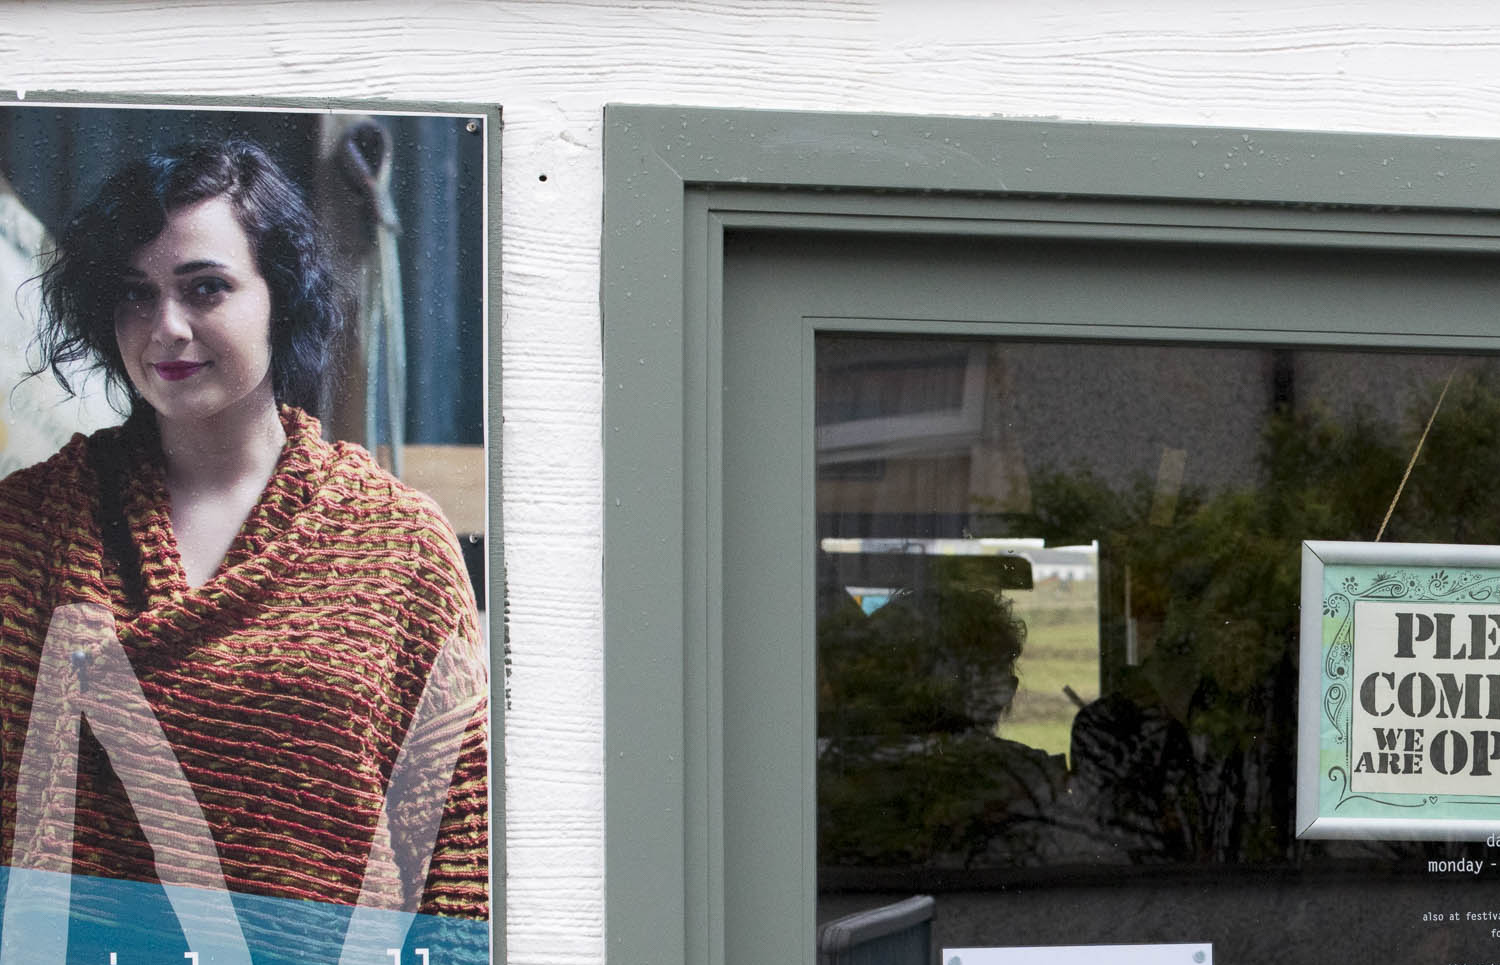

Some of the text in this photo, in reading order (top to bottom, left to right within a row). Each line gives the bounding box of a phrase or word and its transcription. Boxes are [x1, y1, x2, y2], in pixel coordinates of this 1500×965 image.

[1372, 727, 1424, 752] WE
[1354, 751, 1423, 774] ARE
[1428, 857, 1483, 874] monday
[1422, 911, 1444, 921] also
[1449, 911, 1460, 920] at
